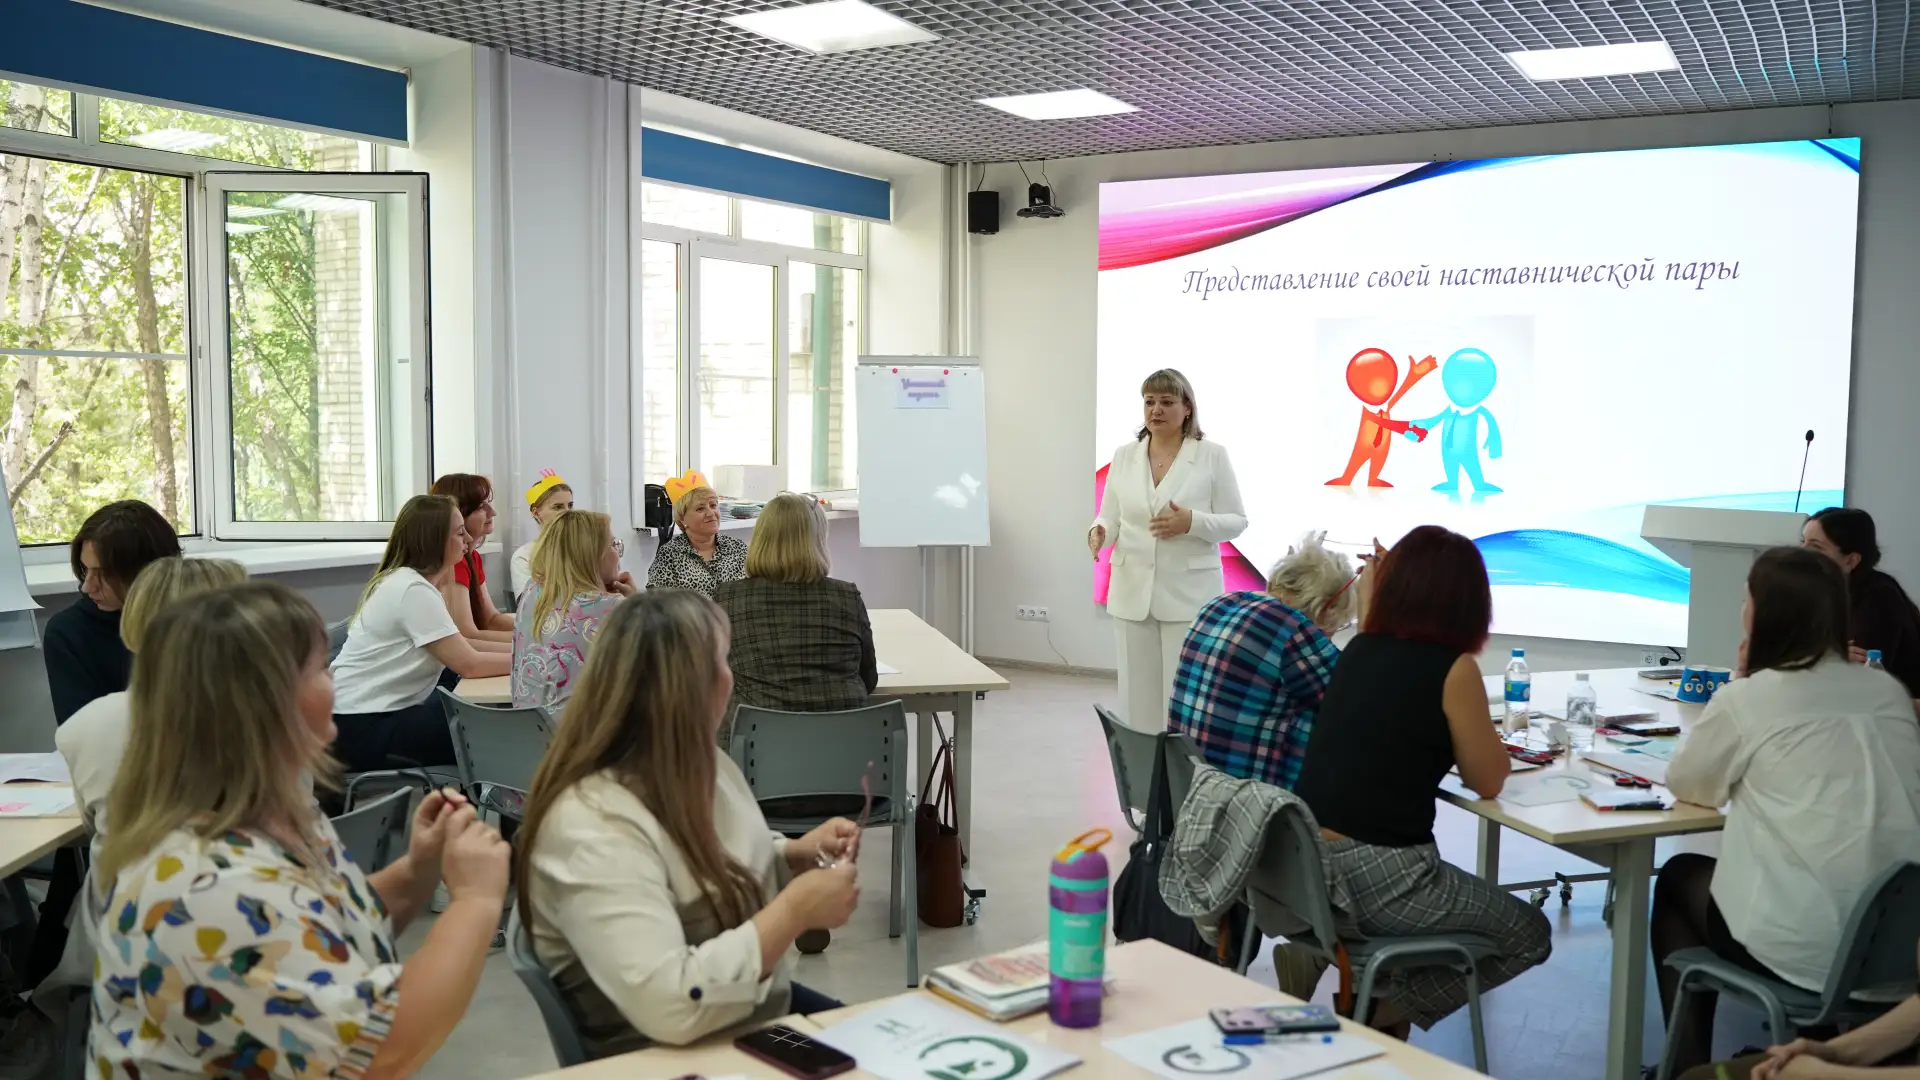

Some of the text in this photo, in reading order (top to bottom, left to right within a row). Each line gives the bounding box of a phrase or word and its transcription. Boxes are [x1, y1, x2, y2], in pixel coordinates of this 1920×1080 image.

[1182, 257, 1741, 301] Представление своей наставнической пары
